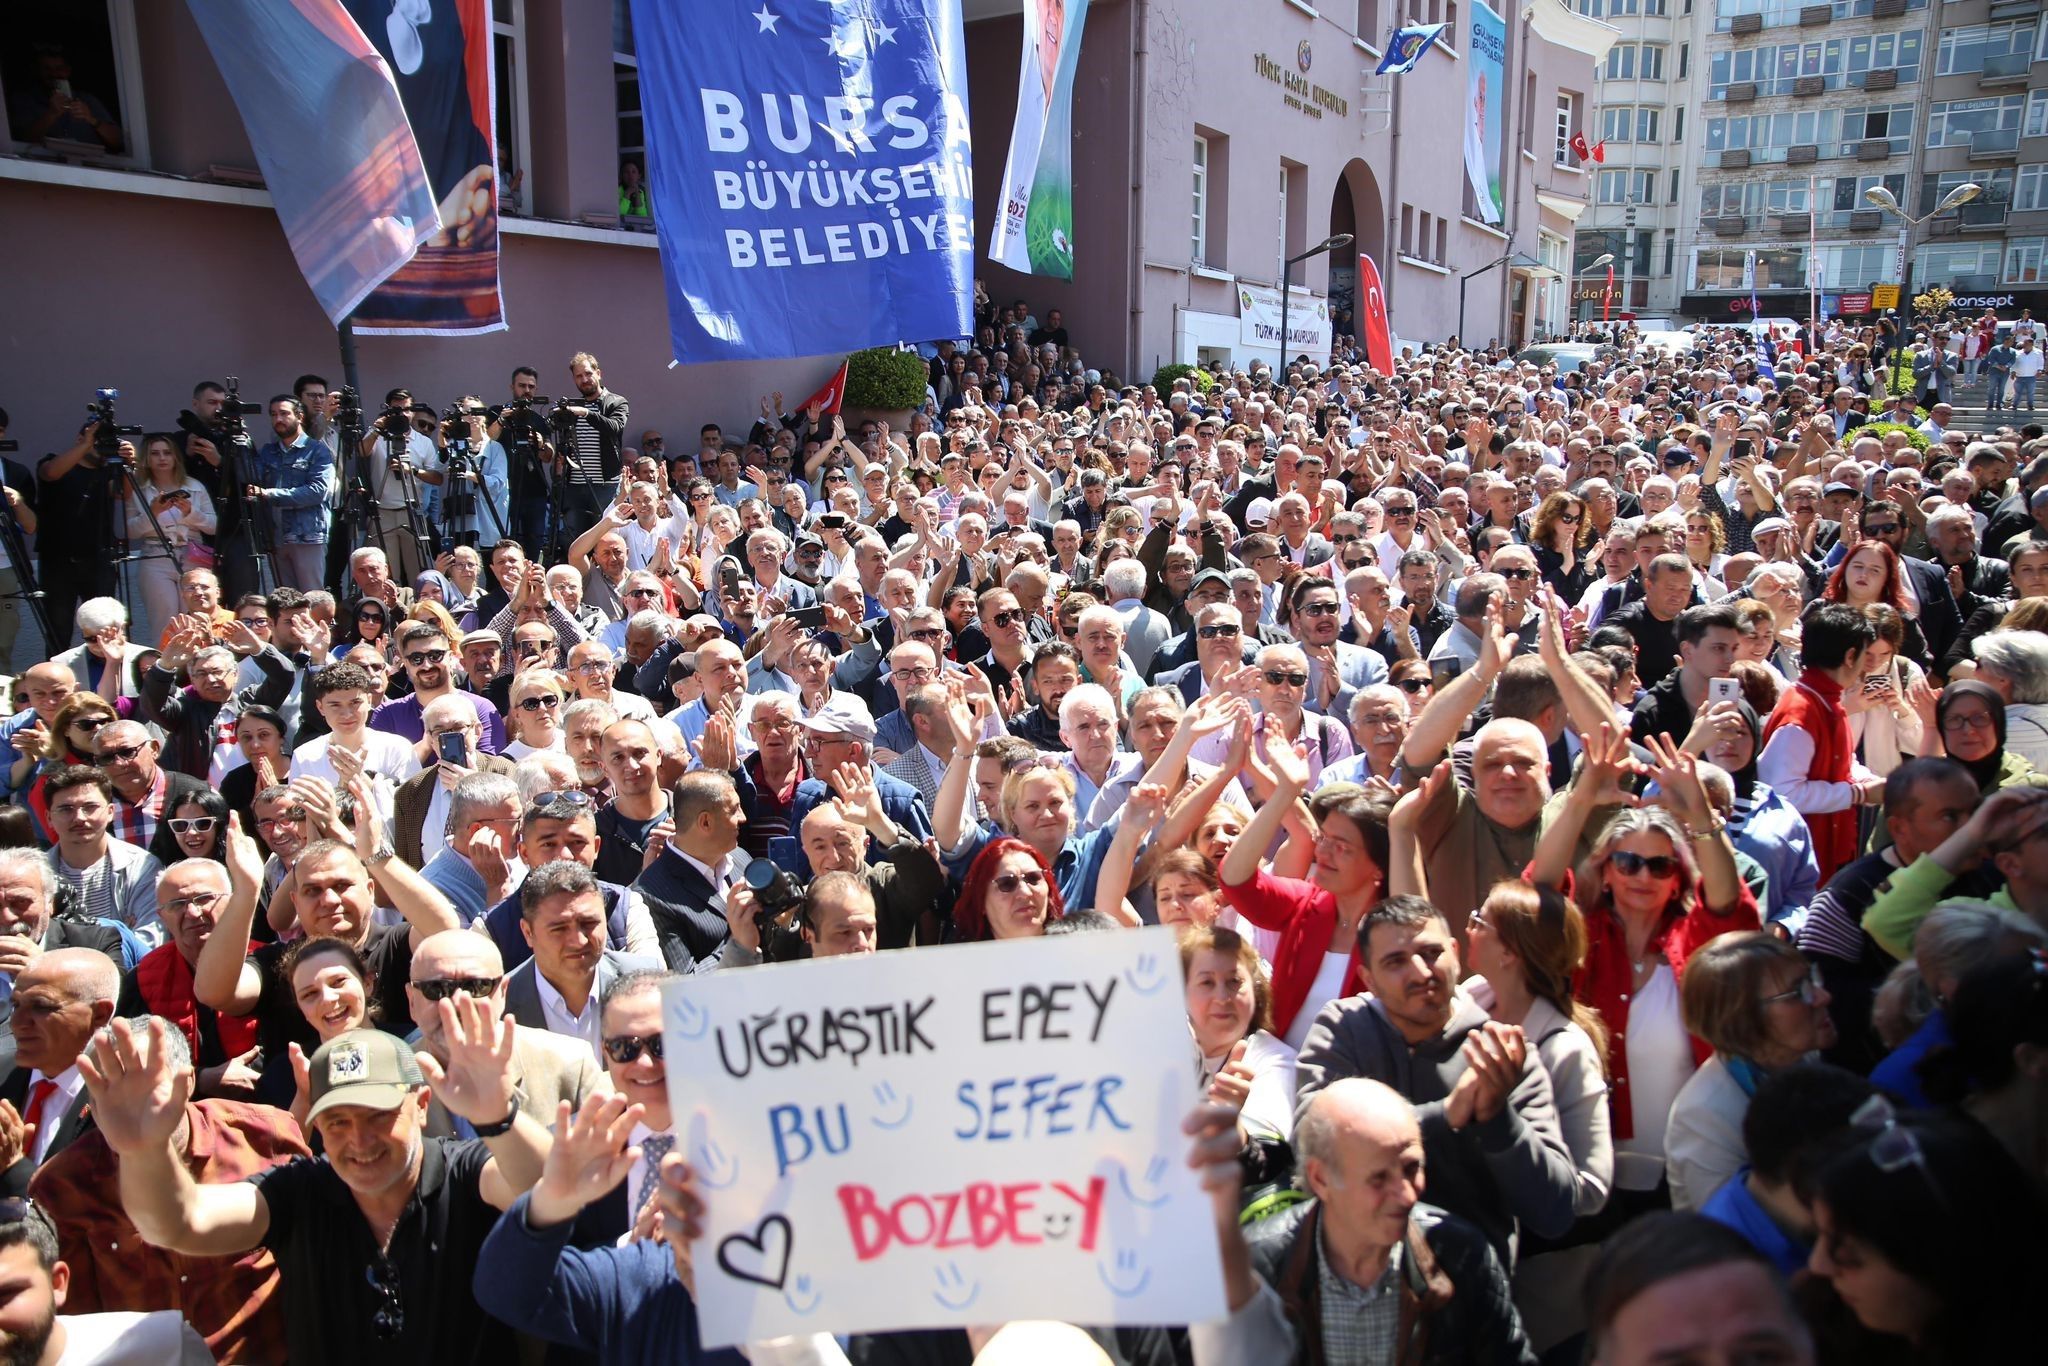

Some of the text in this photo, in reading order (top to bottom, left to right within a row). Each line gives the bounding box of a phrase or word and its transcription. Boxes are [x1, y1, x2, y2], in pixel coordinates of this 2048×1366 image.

[1254, 53, 1347, 117] TÜRK HAVA KURUMU
[701, 88, 971, 153] BURSA
[1896, 244, 1904, 277] BOSCH
[1728, 297, 1762, 312] eve
[1948, 293, 2014, 308] konsept
[1255, 322, 1274, 340] TÜRK
[1293, 329, 1319, 345] KURUMU
[715, 977, 1119, 1078] UĞRAŞTIK EPEY
[767, 1073, 1133, 1176] BU SEFER
[836, 1177, 1107, 1262] BOZBEY
